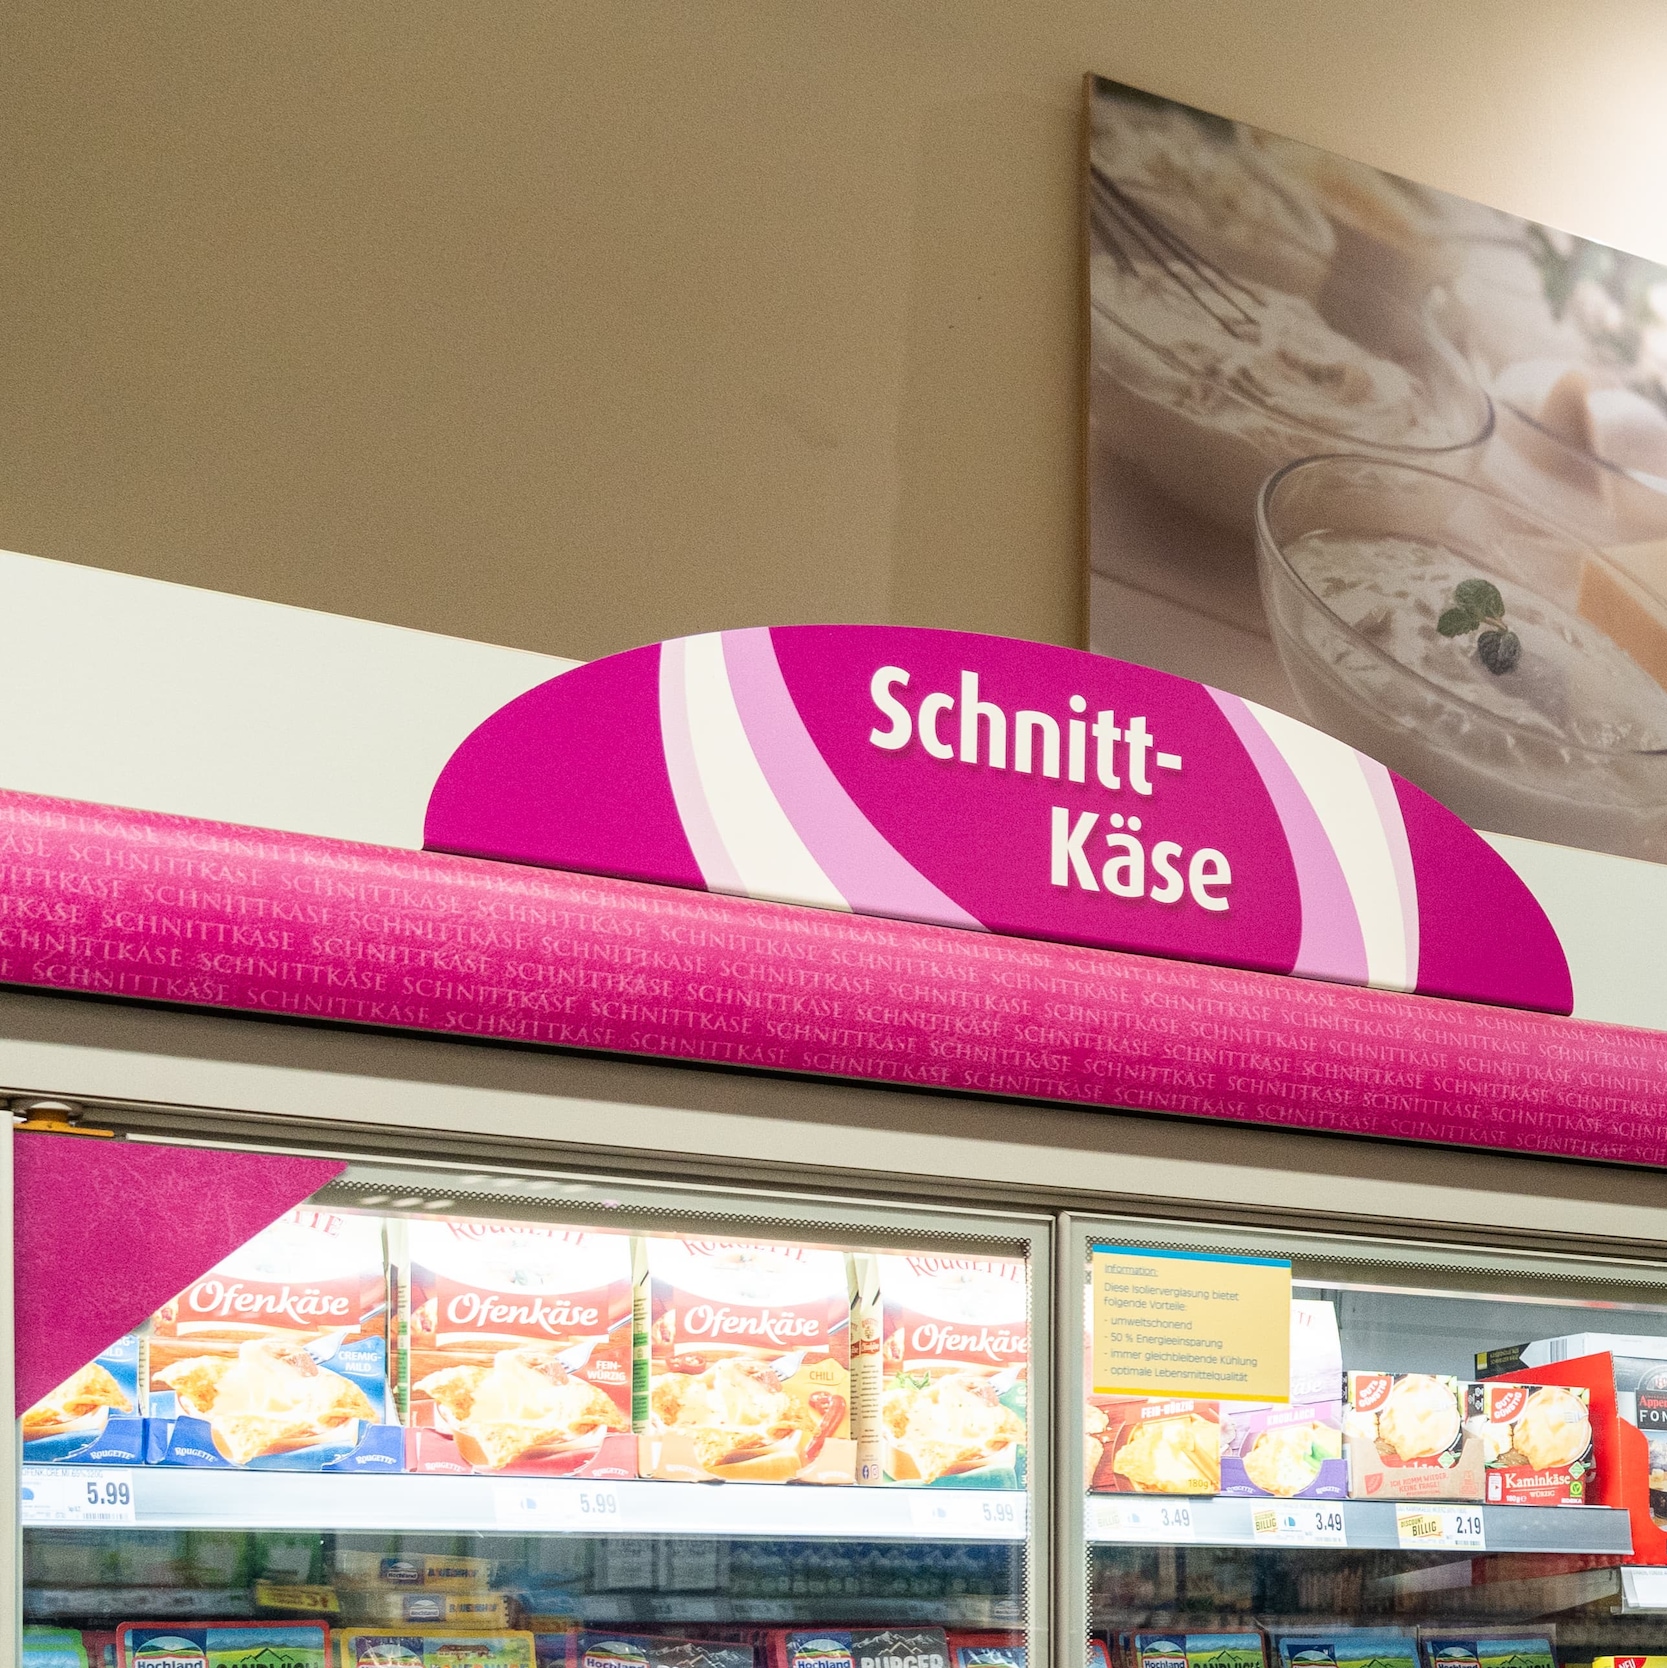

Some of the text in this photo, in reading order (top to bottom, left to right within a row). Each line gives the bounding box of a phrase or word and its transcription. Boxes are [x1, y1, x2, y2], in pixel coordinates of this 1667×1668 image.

[870, 666, 1182, 795] Schnitt-
[1051, 806, 1232, 911] Käse
[1104, 1283, 1239, 1301] Diese Isolierverglasung bietet
[189, 1280, 349, 1325] Ofenkäse
[1104, 1298, 1187, 1311] folgende Vorteile:
[447, 1293, 600, 1339] Ofenkäse
[1111, 1317, 1192, 1330] umweltschonend
[684, 1305, 819, 1345] Ofenkäse
[1111, 1333, 1223, 1349] 50 % Energieeinsparung
[338, 1352, 382, 1362] CREMIG-
[1111, 1351, 1258, 1367] immer gleichbleibende Kühlung
[345, 1362, 371, 1373] MILD
[596, 1360, 621, 1371] FEIN-
[587, 1369, 626, 1383] WÜRZIG
[809, 1370, 834, 1383] CHILI
[1111, 1367, 1248, 1382] optimale Lebensmittelqualität
[1505, 1473, 1571, 1488] Kaminkäse
[87, 1482, 130, 1505] 5.99
[580, 1494, 617, 1514] 5.99
[1316, 1513, 1342, 1531] 3.49
[1456, 1516, 1481, 1535] 2.19
